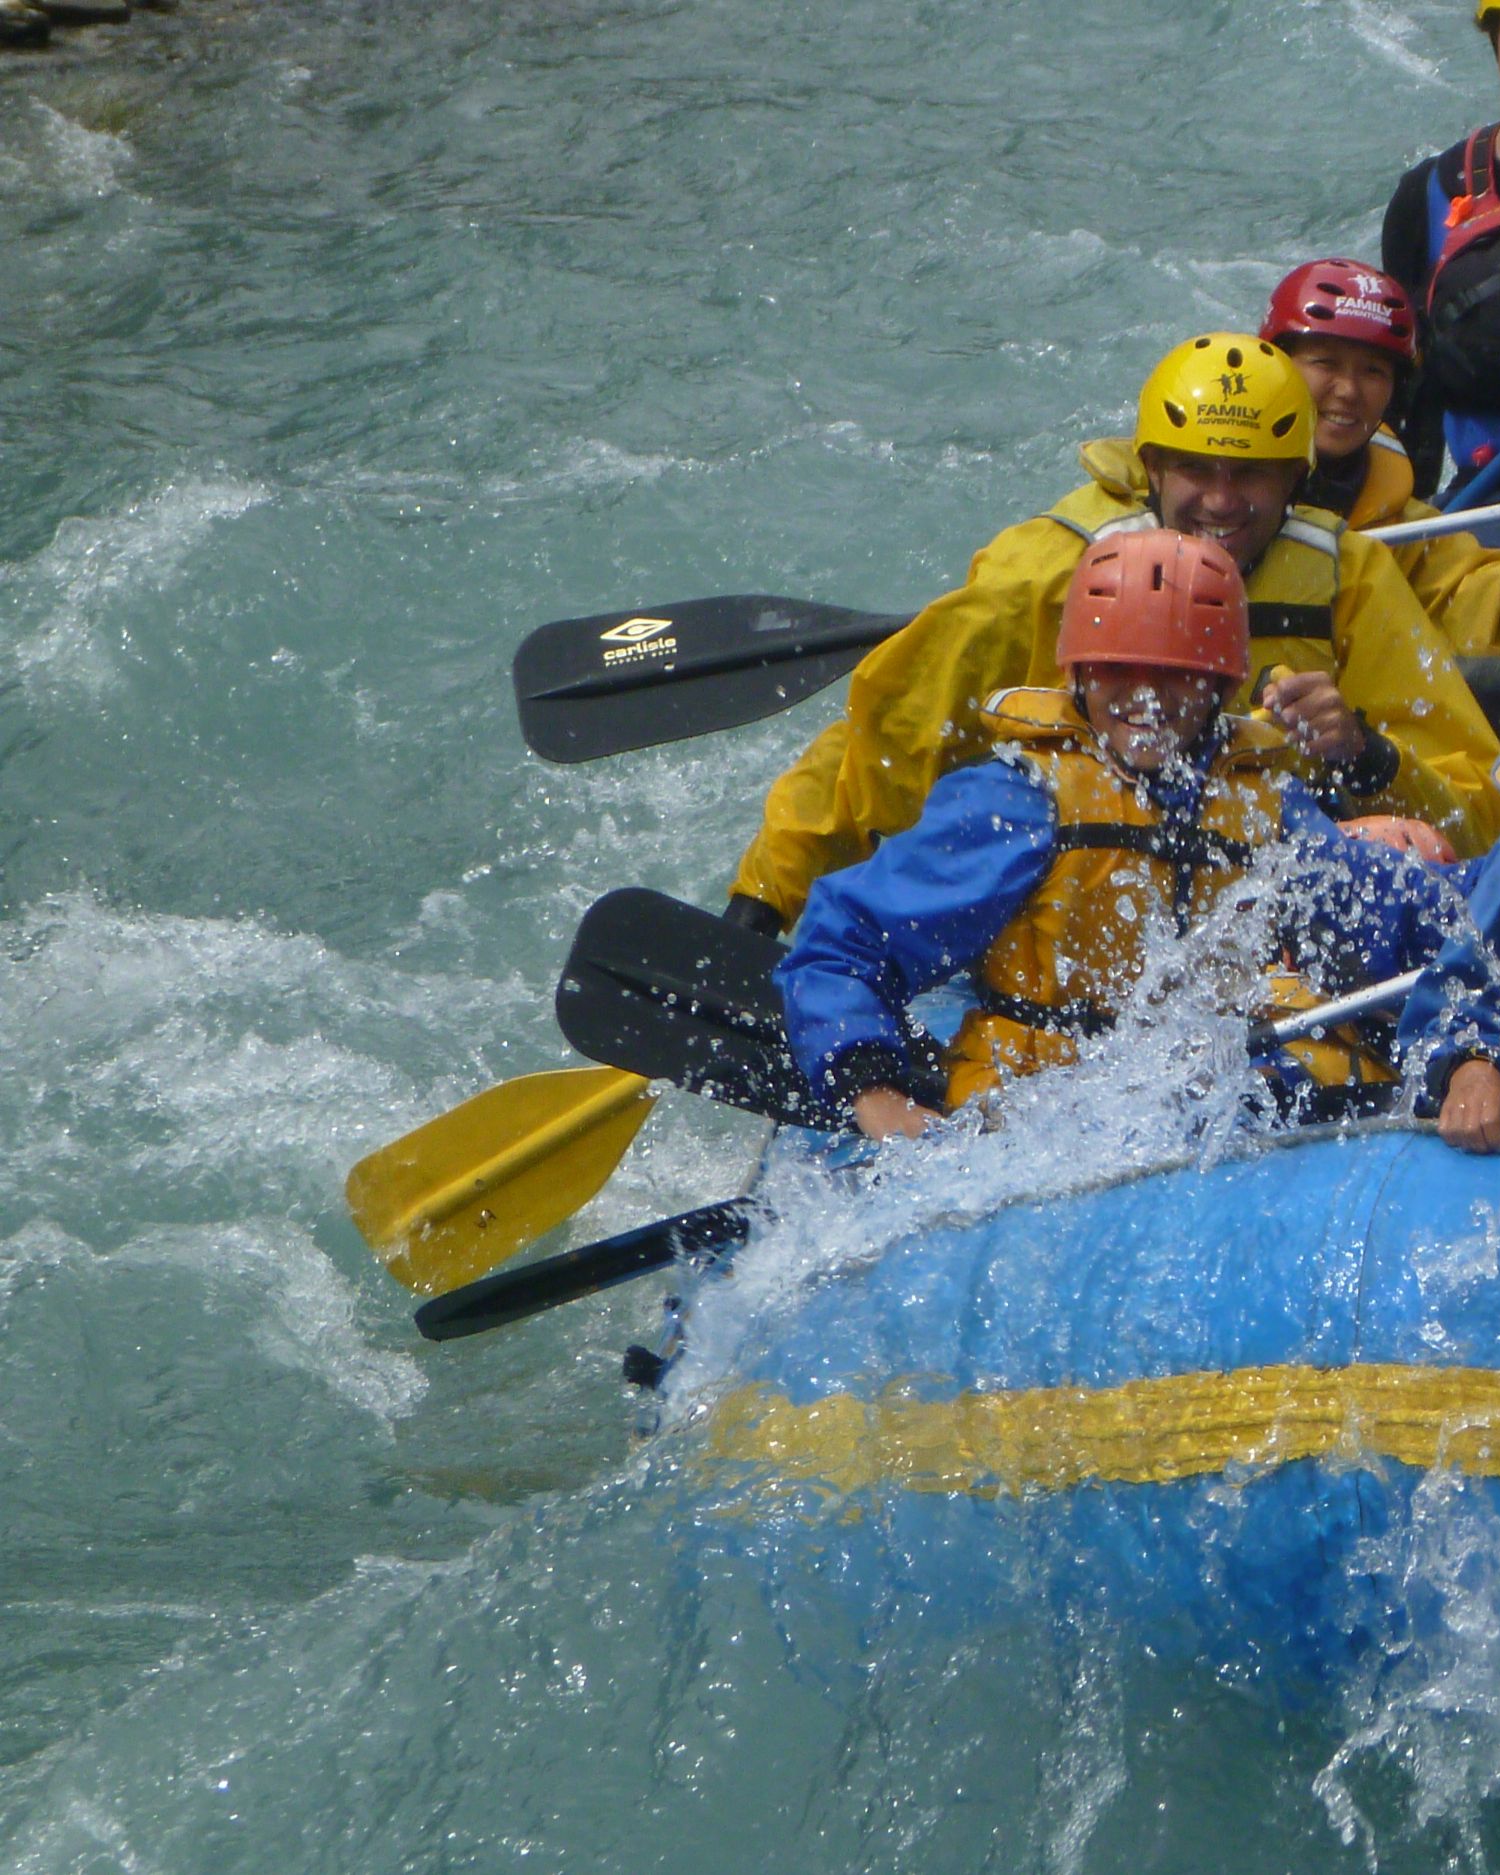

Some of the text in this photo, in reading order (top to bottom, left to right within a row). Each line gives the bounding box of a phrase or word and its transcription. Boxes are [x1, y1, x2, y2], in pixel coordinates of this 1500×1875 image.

[1336, 296, 1392, 317] FAMILY
[1197, 404, 1262, 420] FAMILY
[1207, 436, 1252, 449] NRS
[603, 637, 677, 660] carlisle
